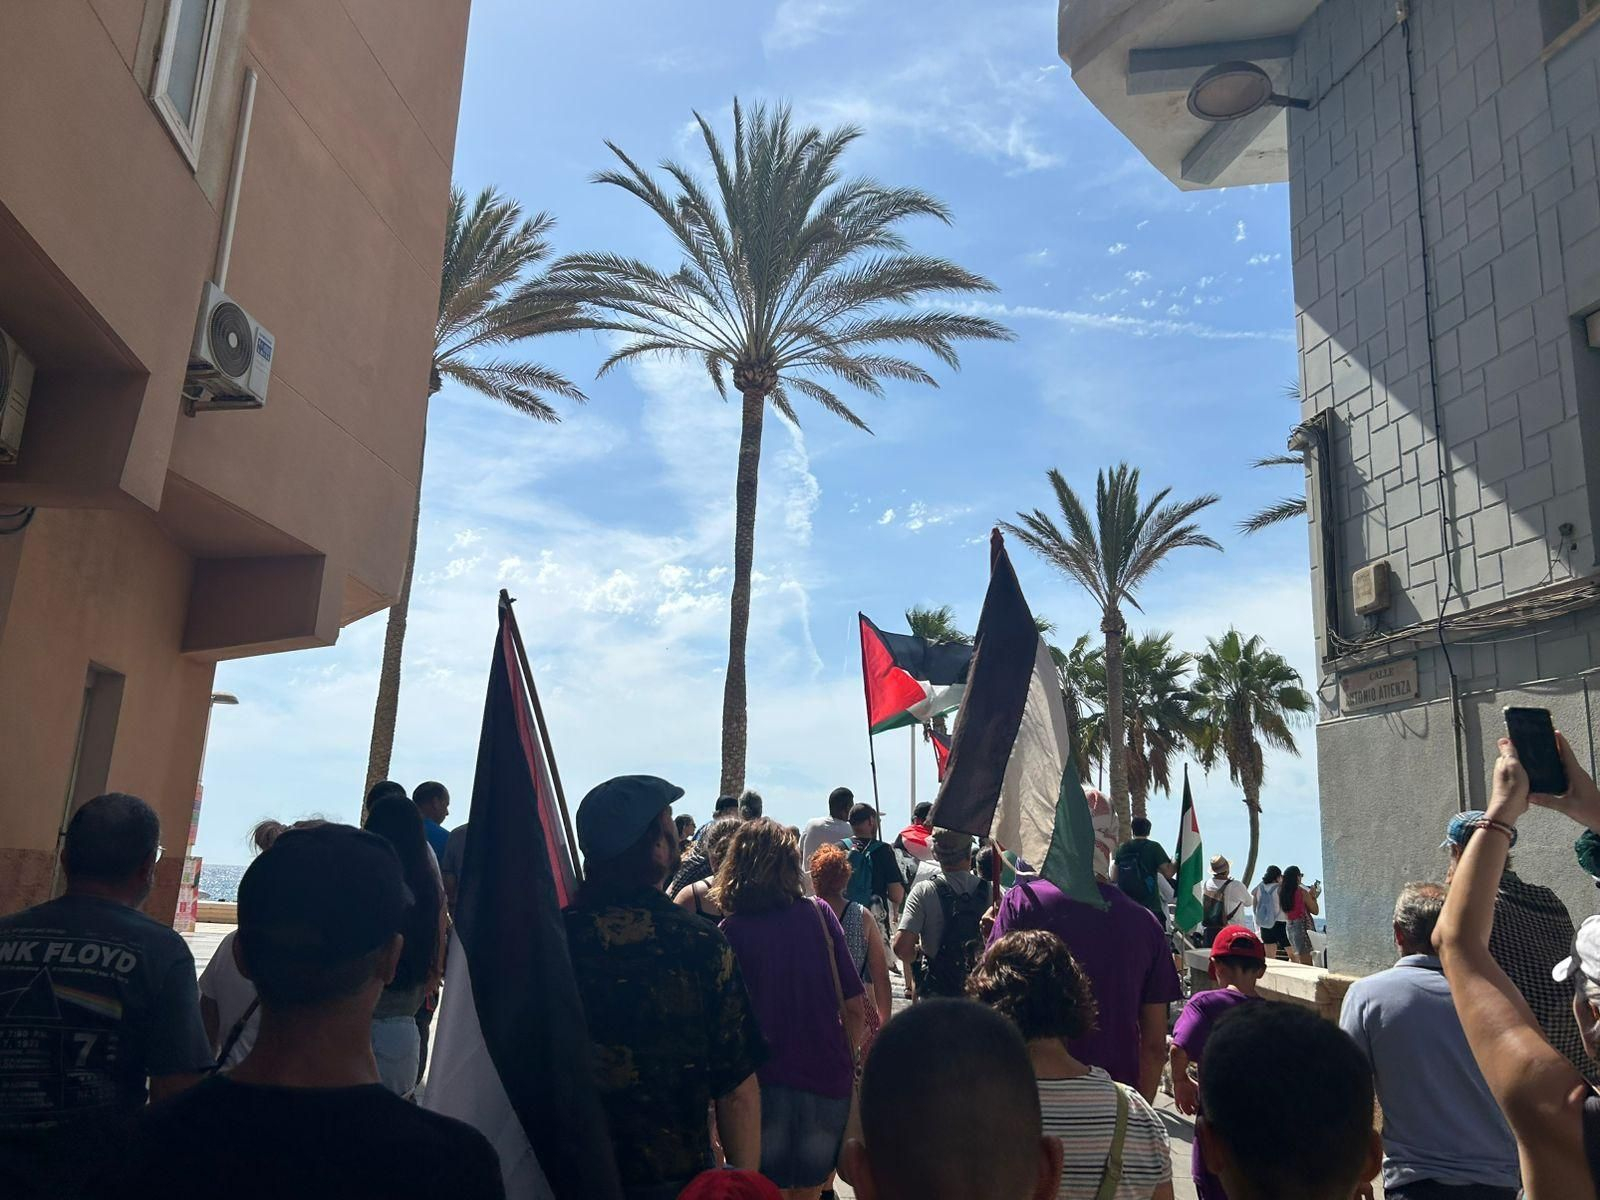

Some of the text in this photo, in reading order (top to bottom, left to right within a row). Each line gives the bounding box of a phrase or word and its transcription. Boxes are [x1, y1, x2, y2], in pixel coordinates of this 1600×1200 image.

[1369, 668, 1394, 681] CALLE
[1379, 680, 1411, 700] ATIENZA
[0, 941, 137, 973] NK FLOYD
[73, 1033, 98, 1067] 7
